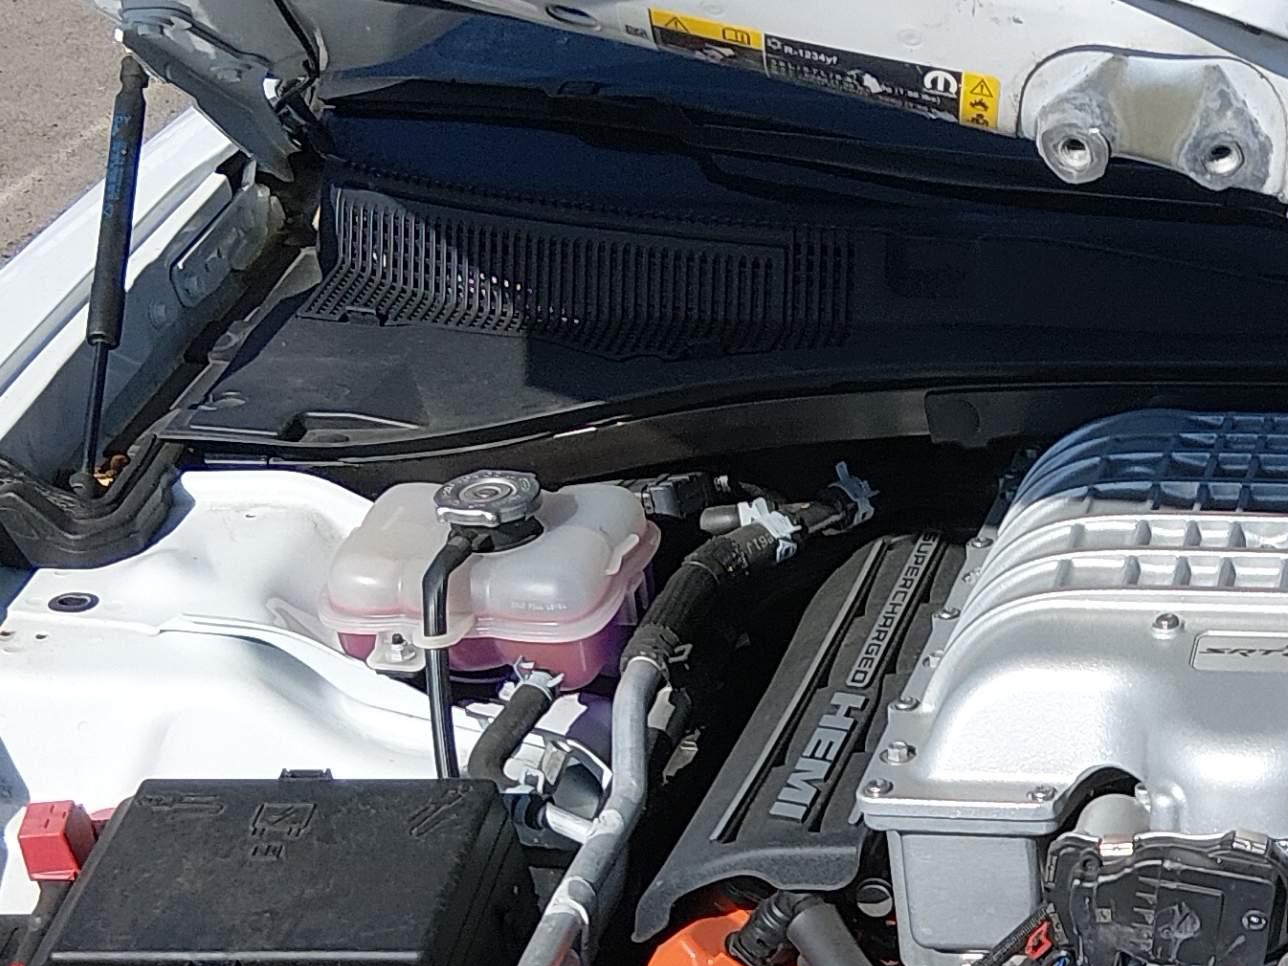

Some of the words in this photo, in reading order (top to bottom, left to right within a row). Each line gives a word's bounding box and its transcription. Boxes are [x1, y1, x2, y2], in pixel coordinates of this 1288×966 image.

[850, 532, 938, 685] SUPERCHARGED
[1199, 647, 1284, 658] SRT
[769, 692, 867, 823] HEMI
